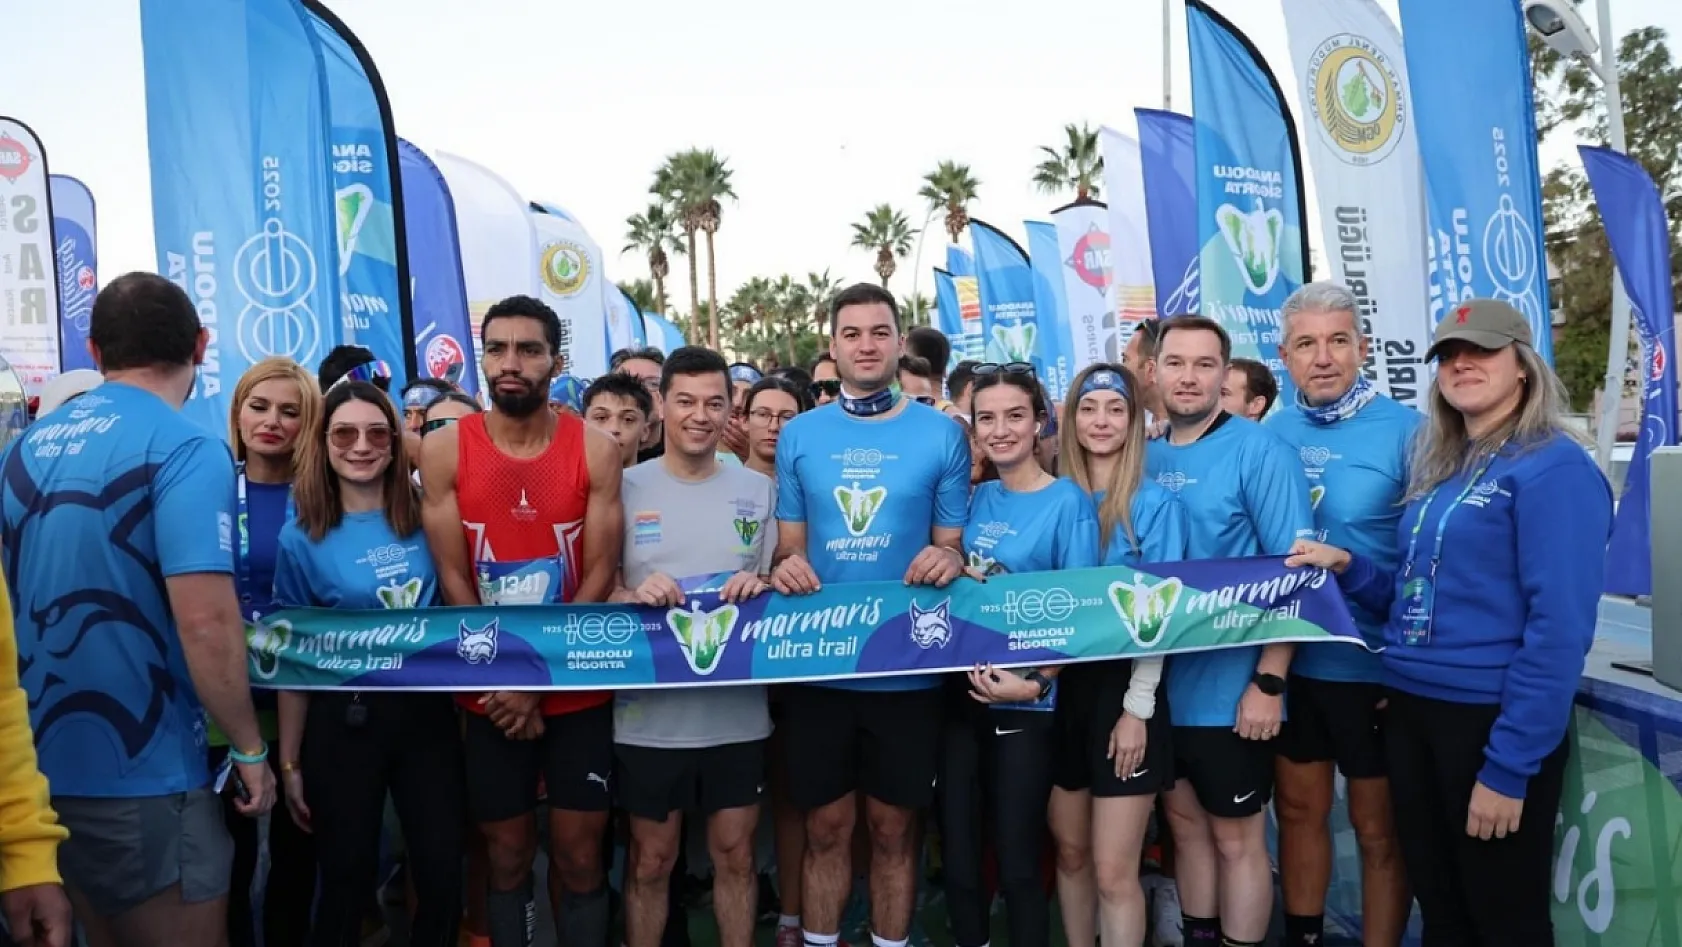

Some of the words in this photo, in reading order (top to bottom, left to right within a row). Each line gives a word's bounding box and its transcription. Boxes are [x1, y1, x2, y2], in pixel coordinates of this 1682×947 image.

[28, 415, 122, 443] marmaris
[825, 532, 892, 551] marmaris
[499, 573, 541, 597] 1341
[1186, 568, 1328, 616] marmaris
[980, 604, 1001, 614] 1925
[1081, 598, 1103, 608] 2025
[740, 597, 884, 644] marmaris
[1213, 608, 1256, 630] ultra
[1260, 602, 1301, 624] trail
[297, 616, 431, 658] marmaris
[542, 626, 563, 635] 1925
[641, 623, 662, 633] 2025
[1008, 625, 1075, 640] ANADOLU
[767, 639, 813, 660] ultra
[818, 636, 857, 657] trail
[1008, 637, 1068, 652] SİGORTA
[317, 653, 362, 671] ultra
[365, 652, 404, 670] trail
[567, 649, 633, 660] ANADOLU
[567, 659, 626, 670] SİGORTA
